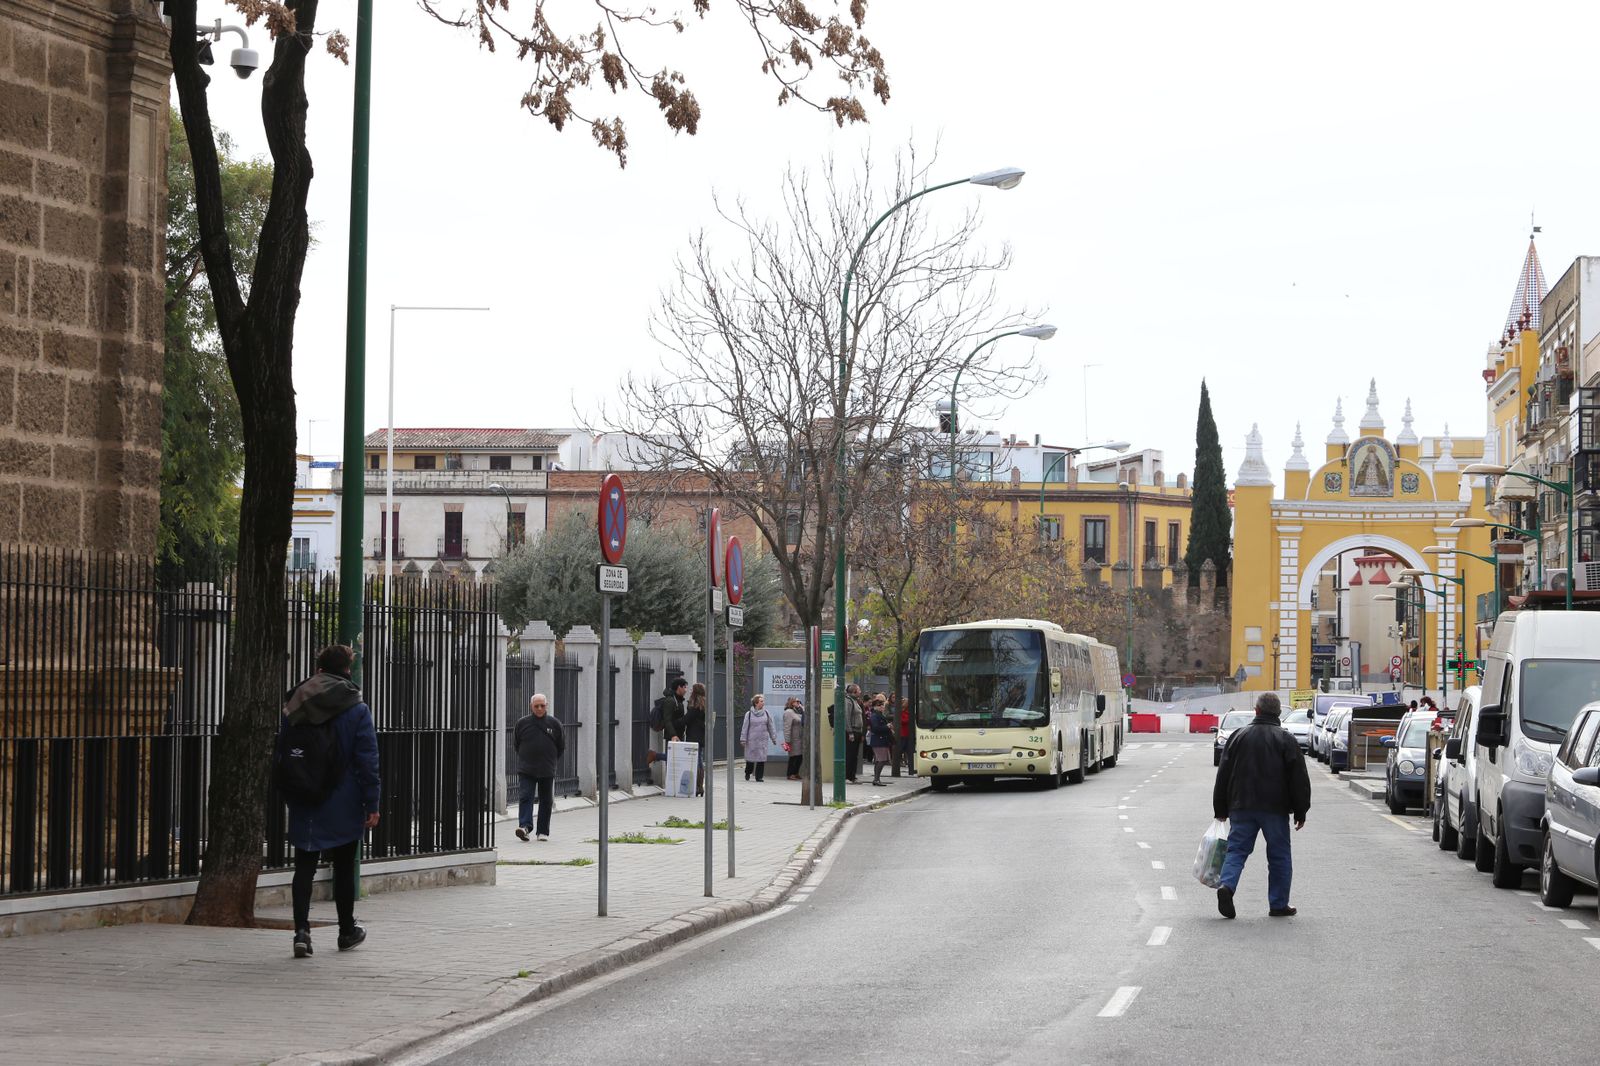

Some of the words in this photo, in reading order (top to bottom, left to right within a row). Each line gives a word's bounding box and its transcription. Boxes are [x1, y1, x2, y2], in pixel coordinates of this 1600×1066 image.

[606, 569, 616, 577] ZONA
[617, 570, 623, 578] DE
[604, 579, 624, 589] SEGURIDAD
